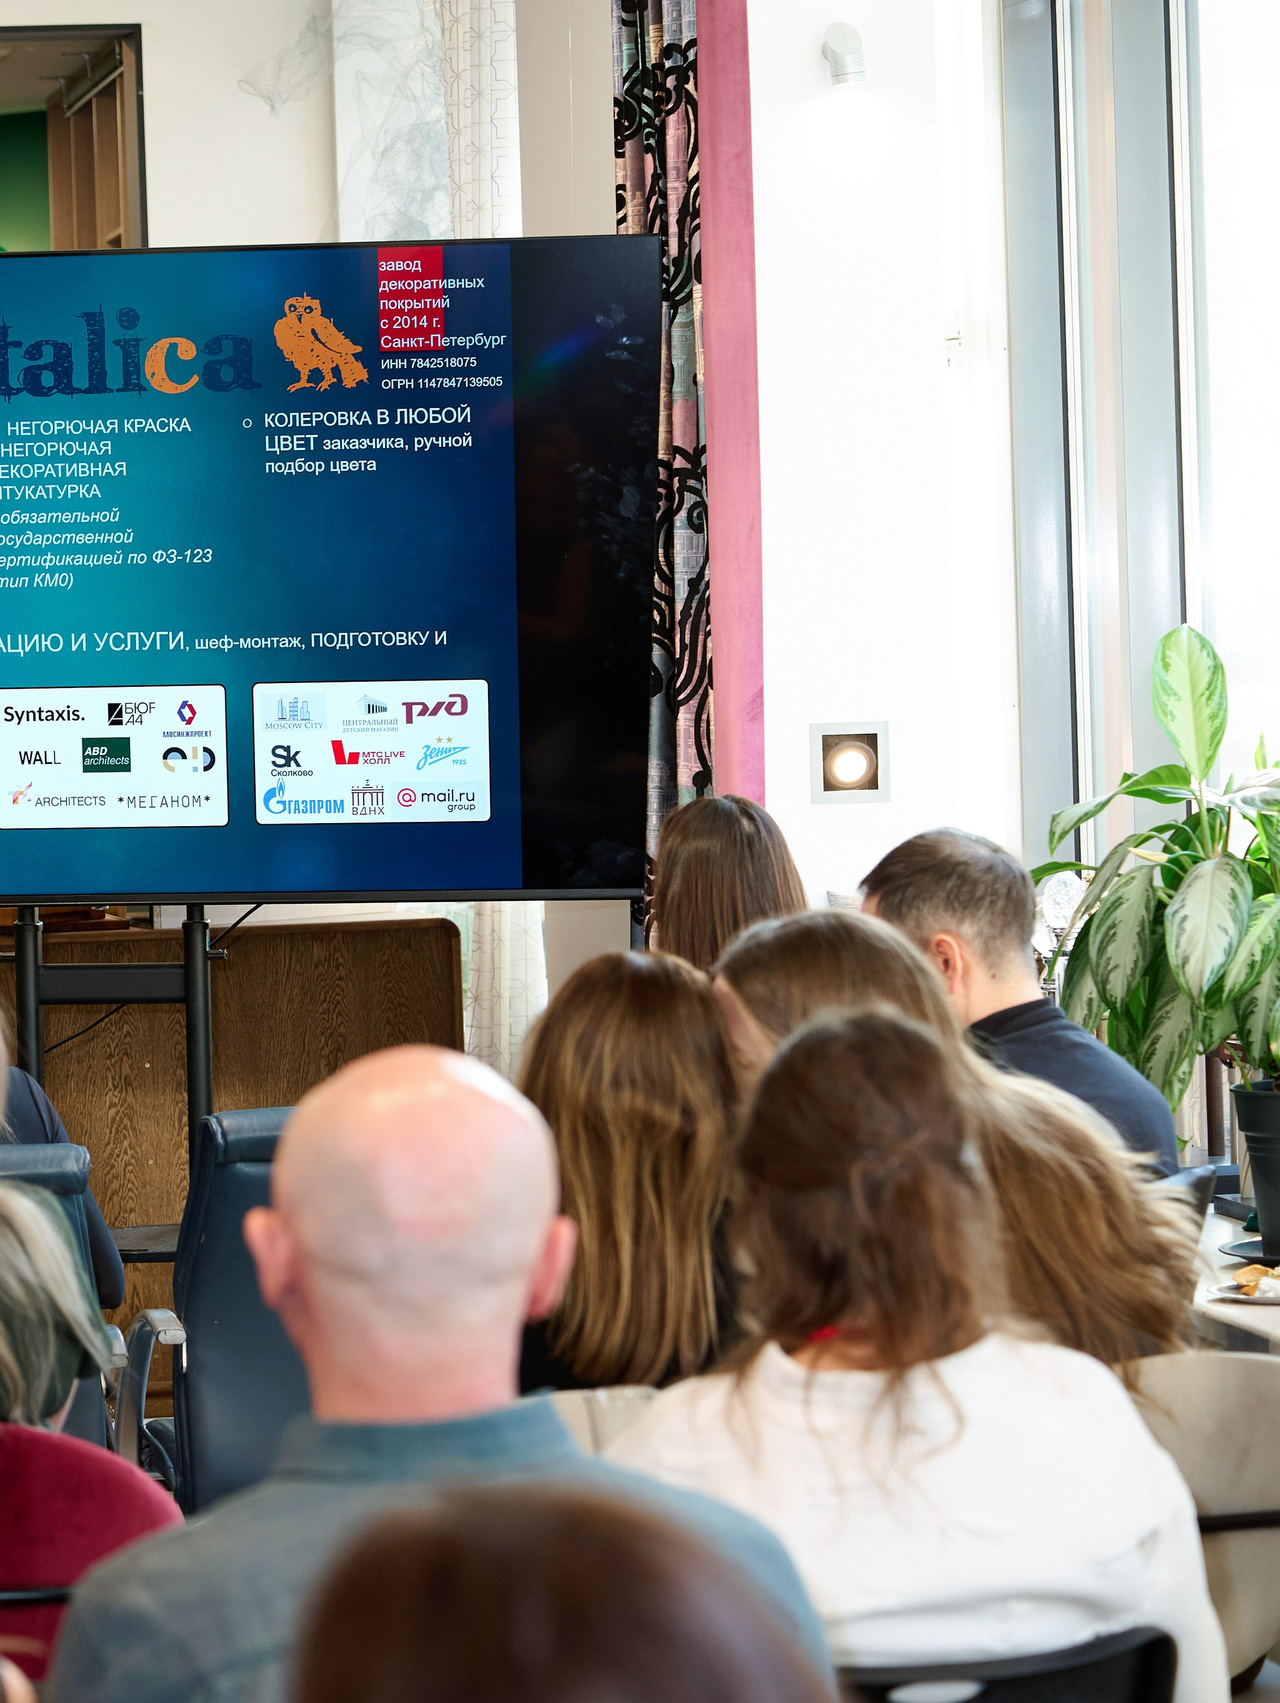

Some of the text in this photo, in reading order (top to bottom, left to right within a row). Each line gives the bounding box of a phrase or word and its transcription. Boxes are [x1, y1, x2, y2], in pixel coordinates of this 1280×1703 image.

[379, 260, 422, 273] завод
[379, 277, 485, 292] декоративных
[380, 295, 450, 312] покрытий
[380, 315, 441, 329] с 2014 г.
[380, 333, 506, 349] Санкт-Петербург
[381, 357, 477, 369] ИНН 7842518075
[381, 376, 503, 389] ОГРН 1147847139505
[264, 404, 471, 428] КОЛЕРОВКА В ЛЮБОЙ
[7, 418, 192, 436] НЕГОРЮЧАЯ КРАСКА
[1, 441, 112, 458] НЕГОРЮЧАЯ
[265, 433, 472, 455] ЦВЕТ заказчика, ручной
[265, 458, 377, 475] подбор цвета
[1, 508, 120, 524] обязательной
[127, 553, 147, 565] по
[152, 548, 213, 564] ФЗ-123
[33, 573, 74, 590] КМ0)
[71, 633, 87, 651] И
[94, 631, 190, 653] УСЛУГИ,
[195, 633, 306, 653] шеф-монтаж,
[311, 630, 430, 650] ПОДГОТОВКУ
[434, 630, 447, 646] И
[4, 705, 85, 725] Syntaxis.
[342, 718, 399, 727] ЦЕНТРАЛЬНЫЙ
[19, 751, 61, 765] WALL
[84, 747, 107, 756] ABD
[271, 744, 301, 768] Sk
[362, 751, 382, 759] МТС
[84, 756, 130, 766] architects
[271, 768, 313, 777] Сколково
[34, 796, 106, 807] ARCHITECTS
[287, 799, 345, 815] ГАЗПРОМ
[447, 804, 476, 813] group
[352, 807, 385, 815] ВДНХ
